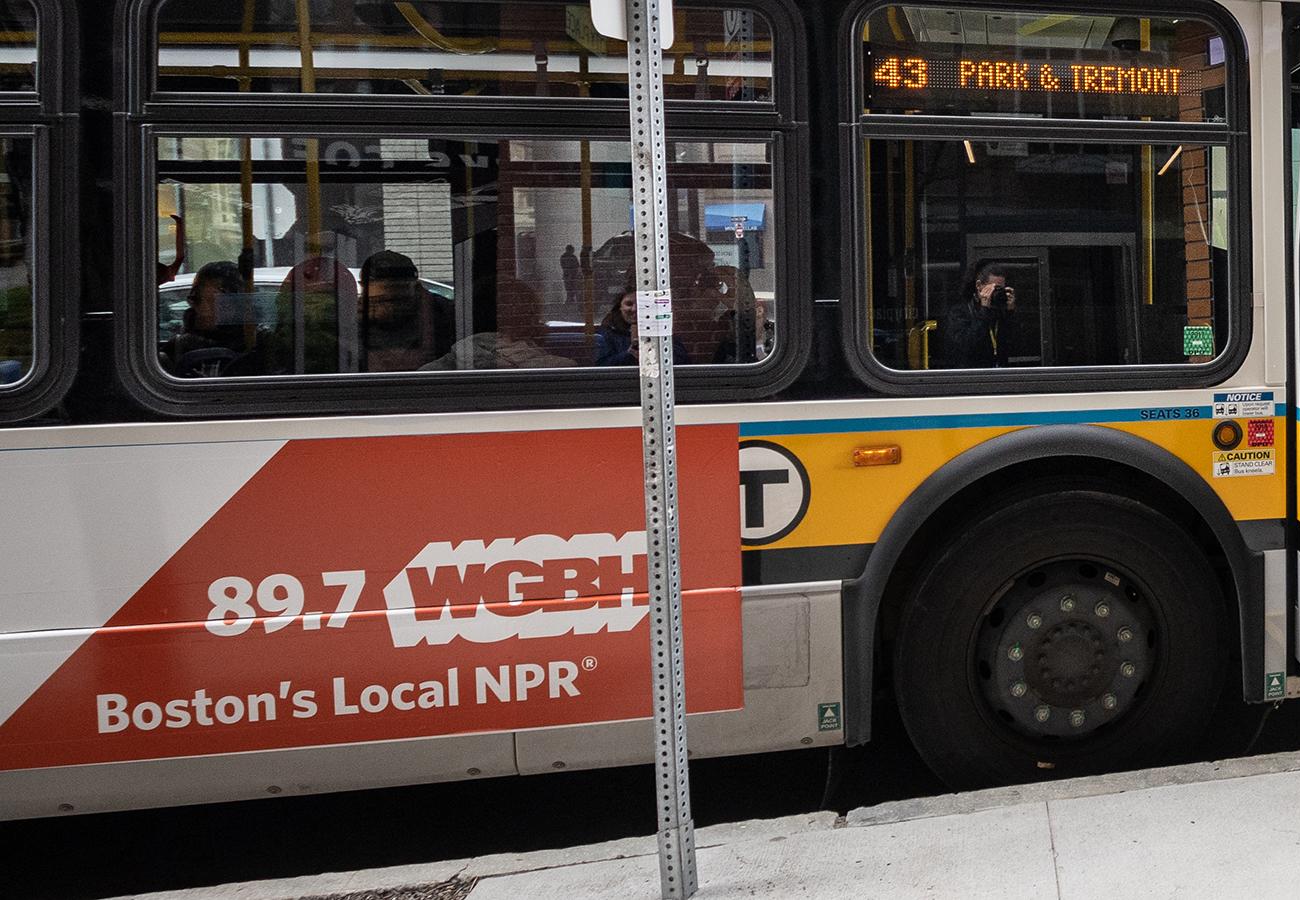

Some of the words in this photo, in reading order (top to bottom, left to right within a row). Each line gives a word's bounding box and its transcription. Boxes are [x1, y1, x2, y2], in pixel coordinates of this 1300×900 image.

[874, 58, 928, 88] 43
[960, 61, 1029, 88] PARK
[1040, 64, 1059, 89] &
[1070, 65, 1181, 93] TREMONT
[1140, 409, 1181, 420] SEATS
[1184, 408, 1200, 418] 36
[1226, 393, 1262, 402] NOTICE
[1226, 451, 1270, 461] CAUTION
[738, 469, 789, 529] T
[205, 569, 367, 637] 89.7
[400, 550, 649, 627] WGBH
[96, 680, 319, 734] Boston's
[333, 667, 459, 716] Local
